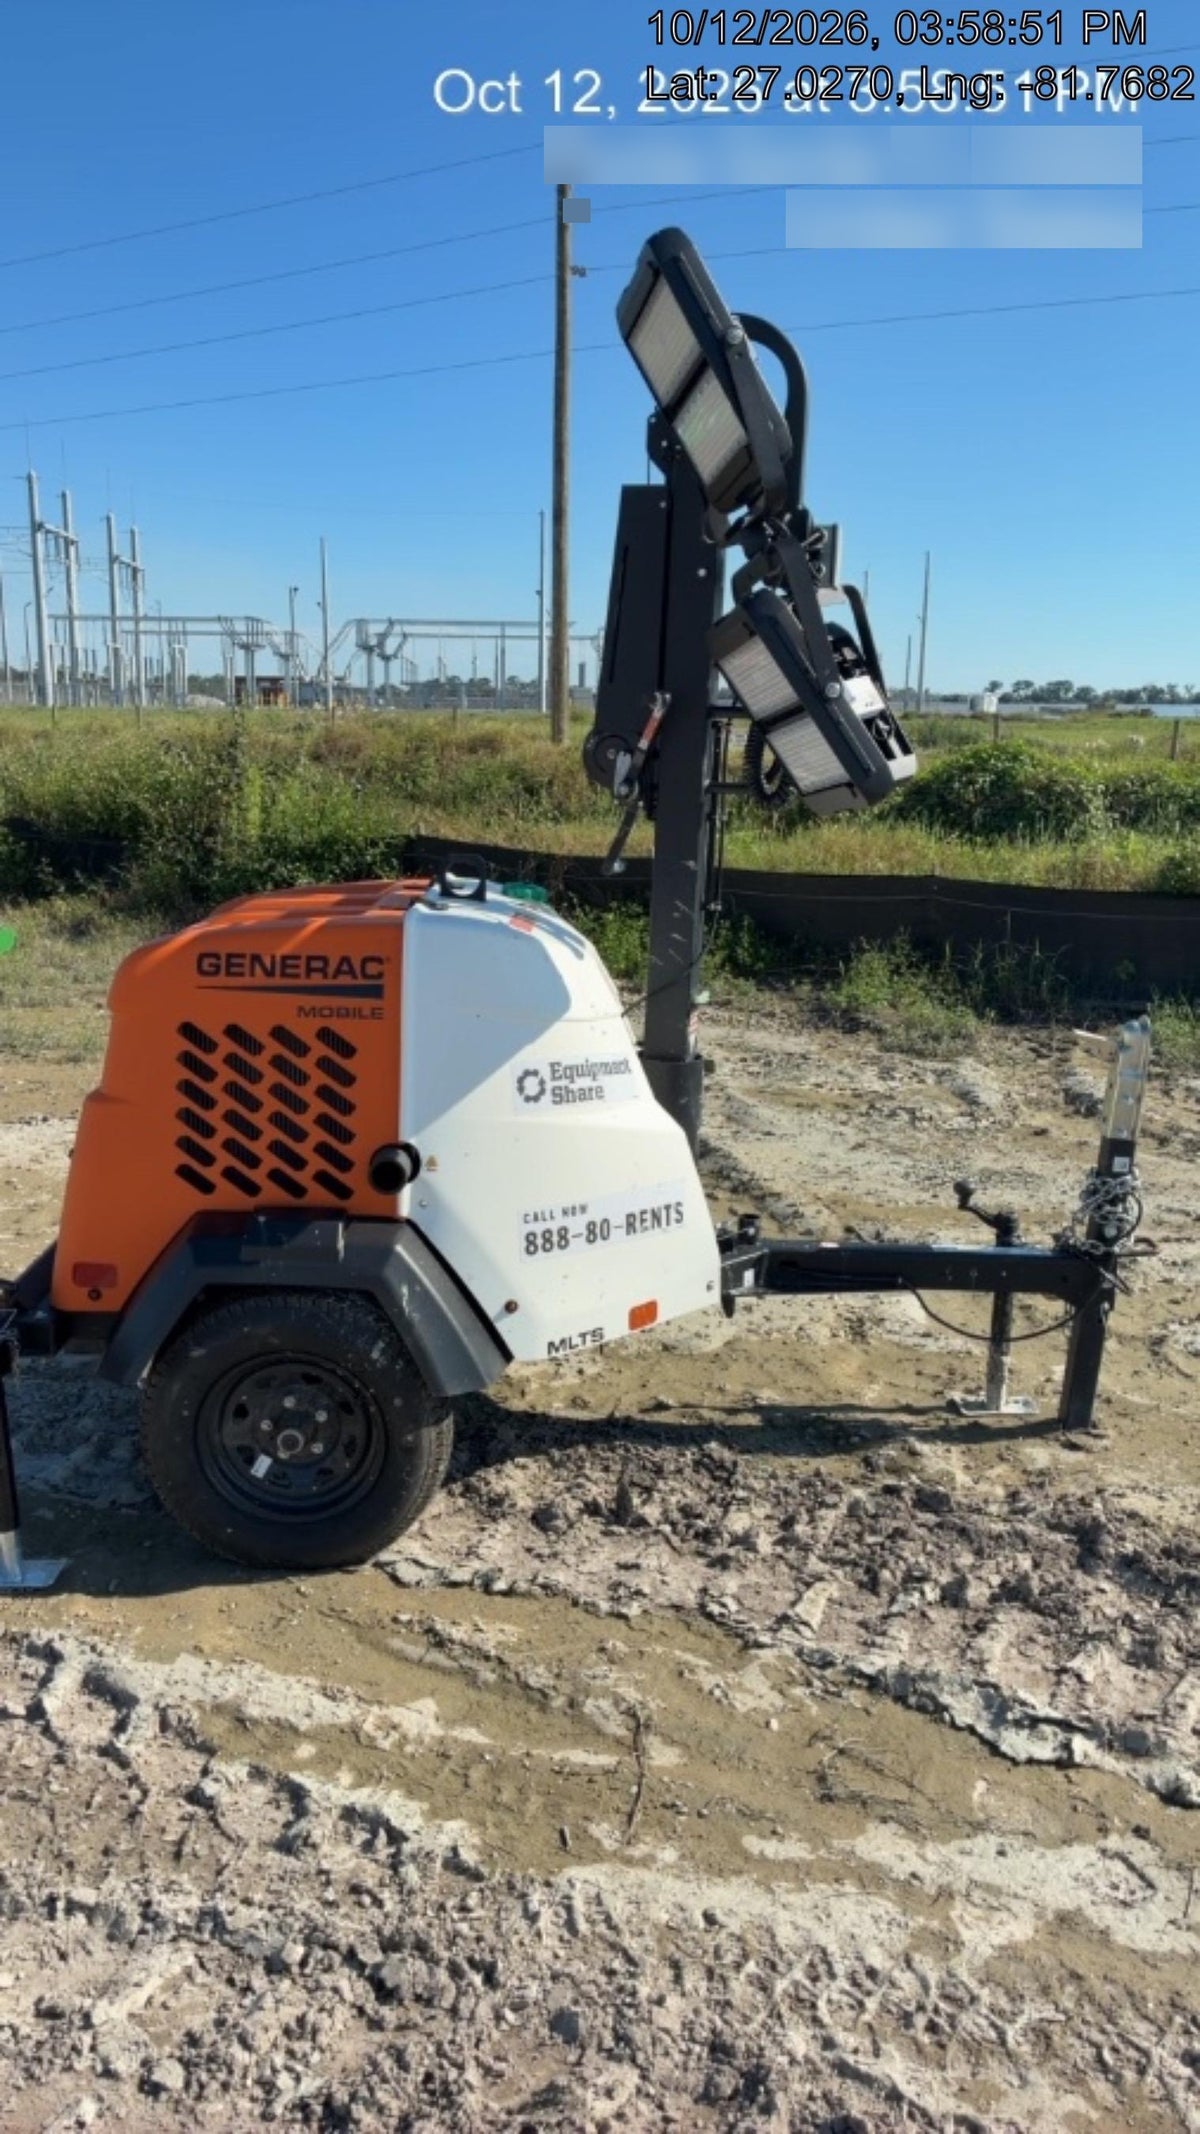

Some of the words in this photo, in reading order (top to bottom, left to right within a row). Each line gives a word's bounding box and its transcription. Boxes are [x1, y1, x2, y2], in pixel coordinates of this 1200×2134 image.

[196, 952, 386, 981] GENERAC
[297, 1005, 385, 1020] MOBILE
[551, 1084, 605, 1105] Share
[523, 1208, 556, 1225] CALL
[561, 1203, 589, 1219] NOW
[524, 1201, 685, 1256] 888-80-RENTS
